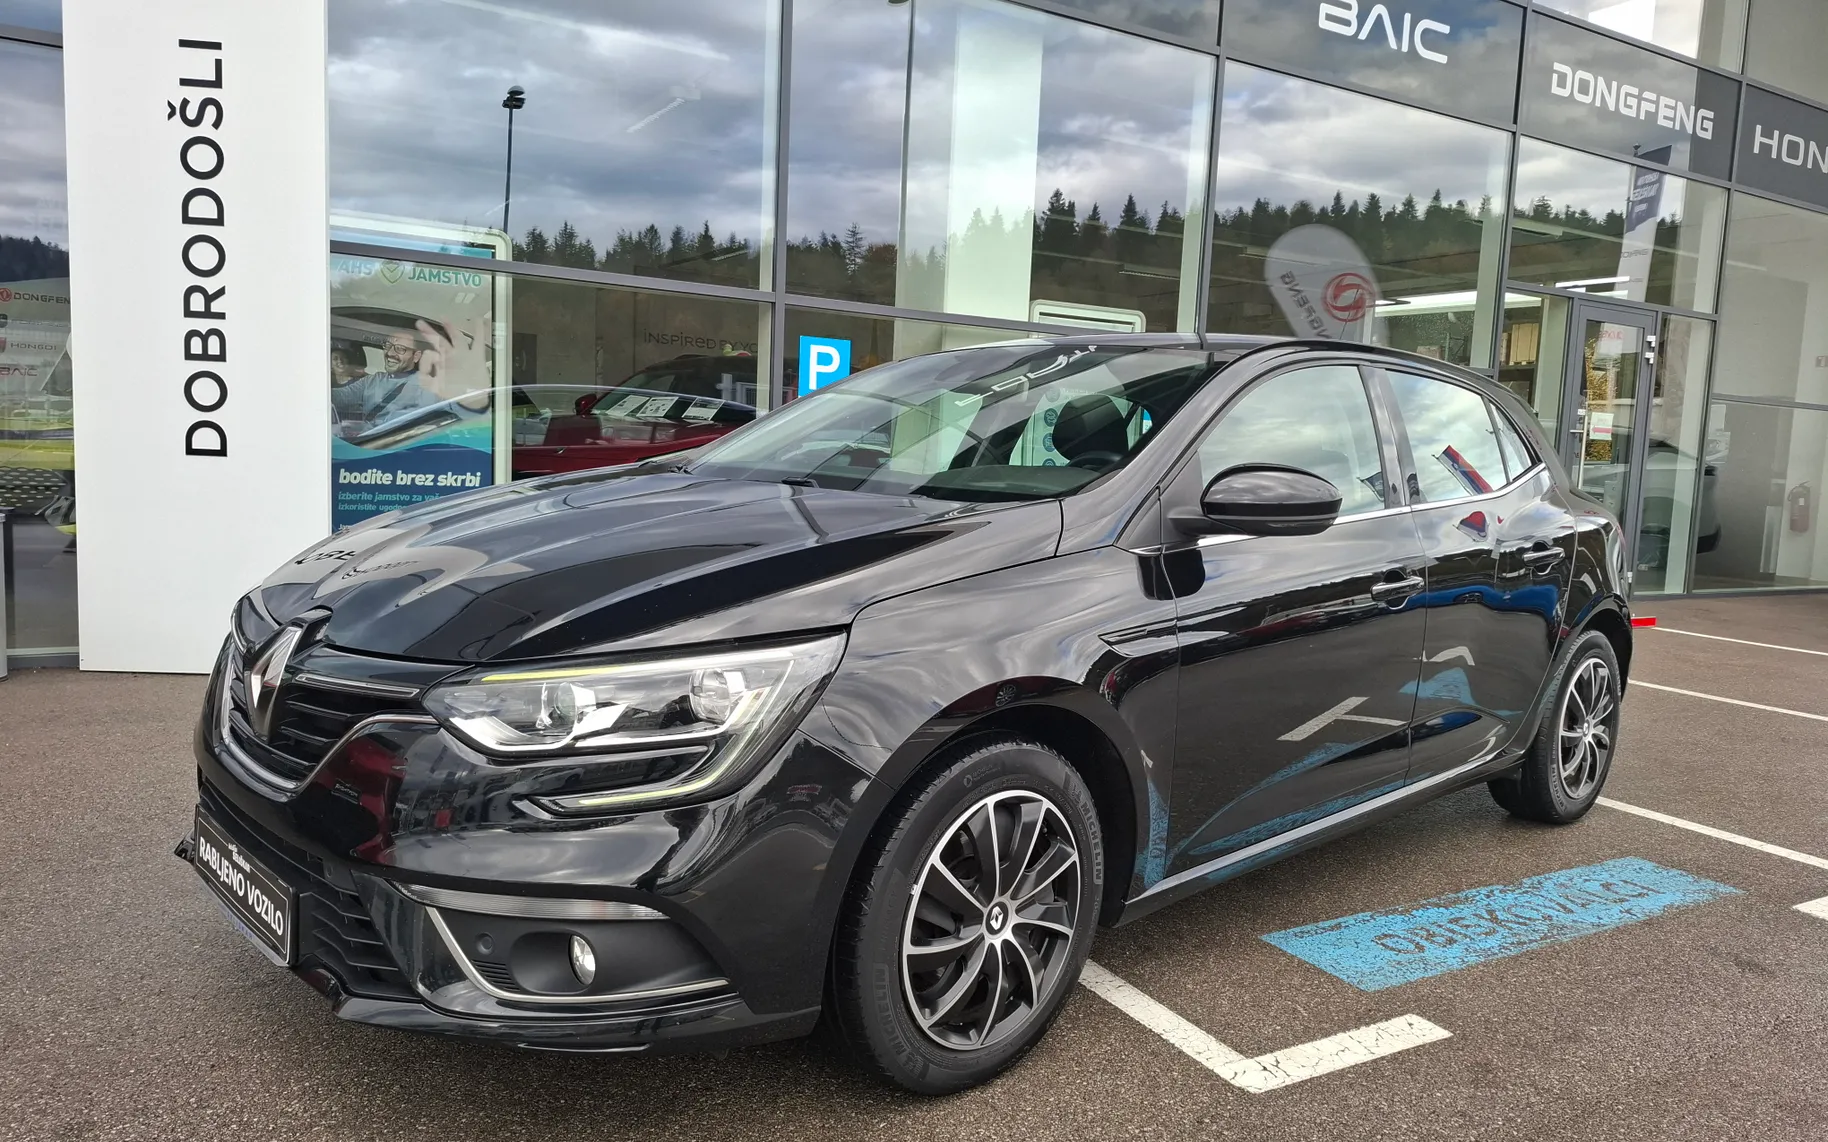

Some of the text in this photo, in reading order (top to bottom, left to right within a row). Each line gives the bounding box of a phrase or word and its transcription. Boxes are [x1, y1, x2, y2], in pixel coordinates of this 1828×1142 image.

[1319, 0, 1450, 64] BAIC
[1551, 62, 1715, 140] DONGFENG
[167, 38, 228, 458] DOBRODOŠLI
[337, 261, 482, 287] AHS JAMSTVO
[808, 344, 841, 390] P
[338, 468, 482, 487] bodite brez skrbi
[338, 491, 373, 500] izberite
[374, 492, 410, 502] jamstvo
[411, 493, 422, 501] za
[338, 502, 377, 511] izkoristite
[1081, 801, 1102, 880] MICHELIN
[199, 836, 245, 897] RABLJENO
[246, 880, 284, 936] VOZILO
